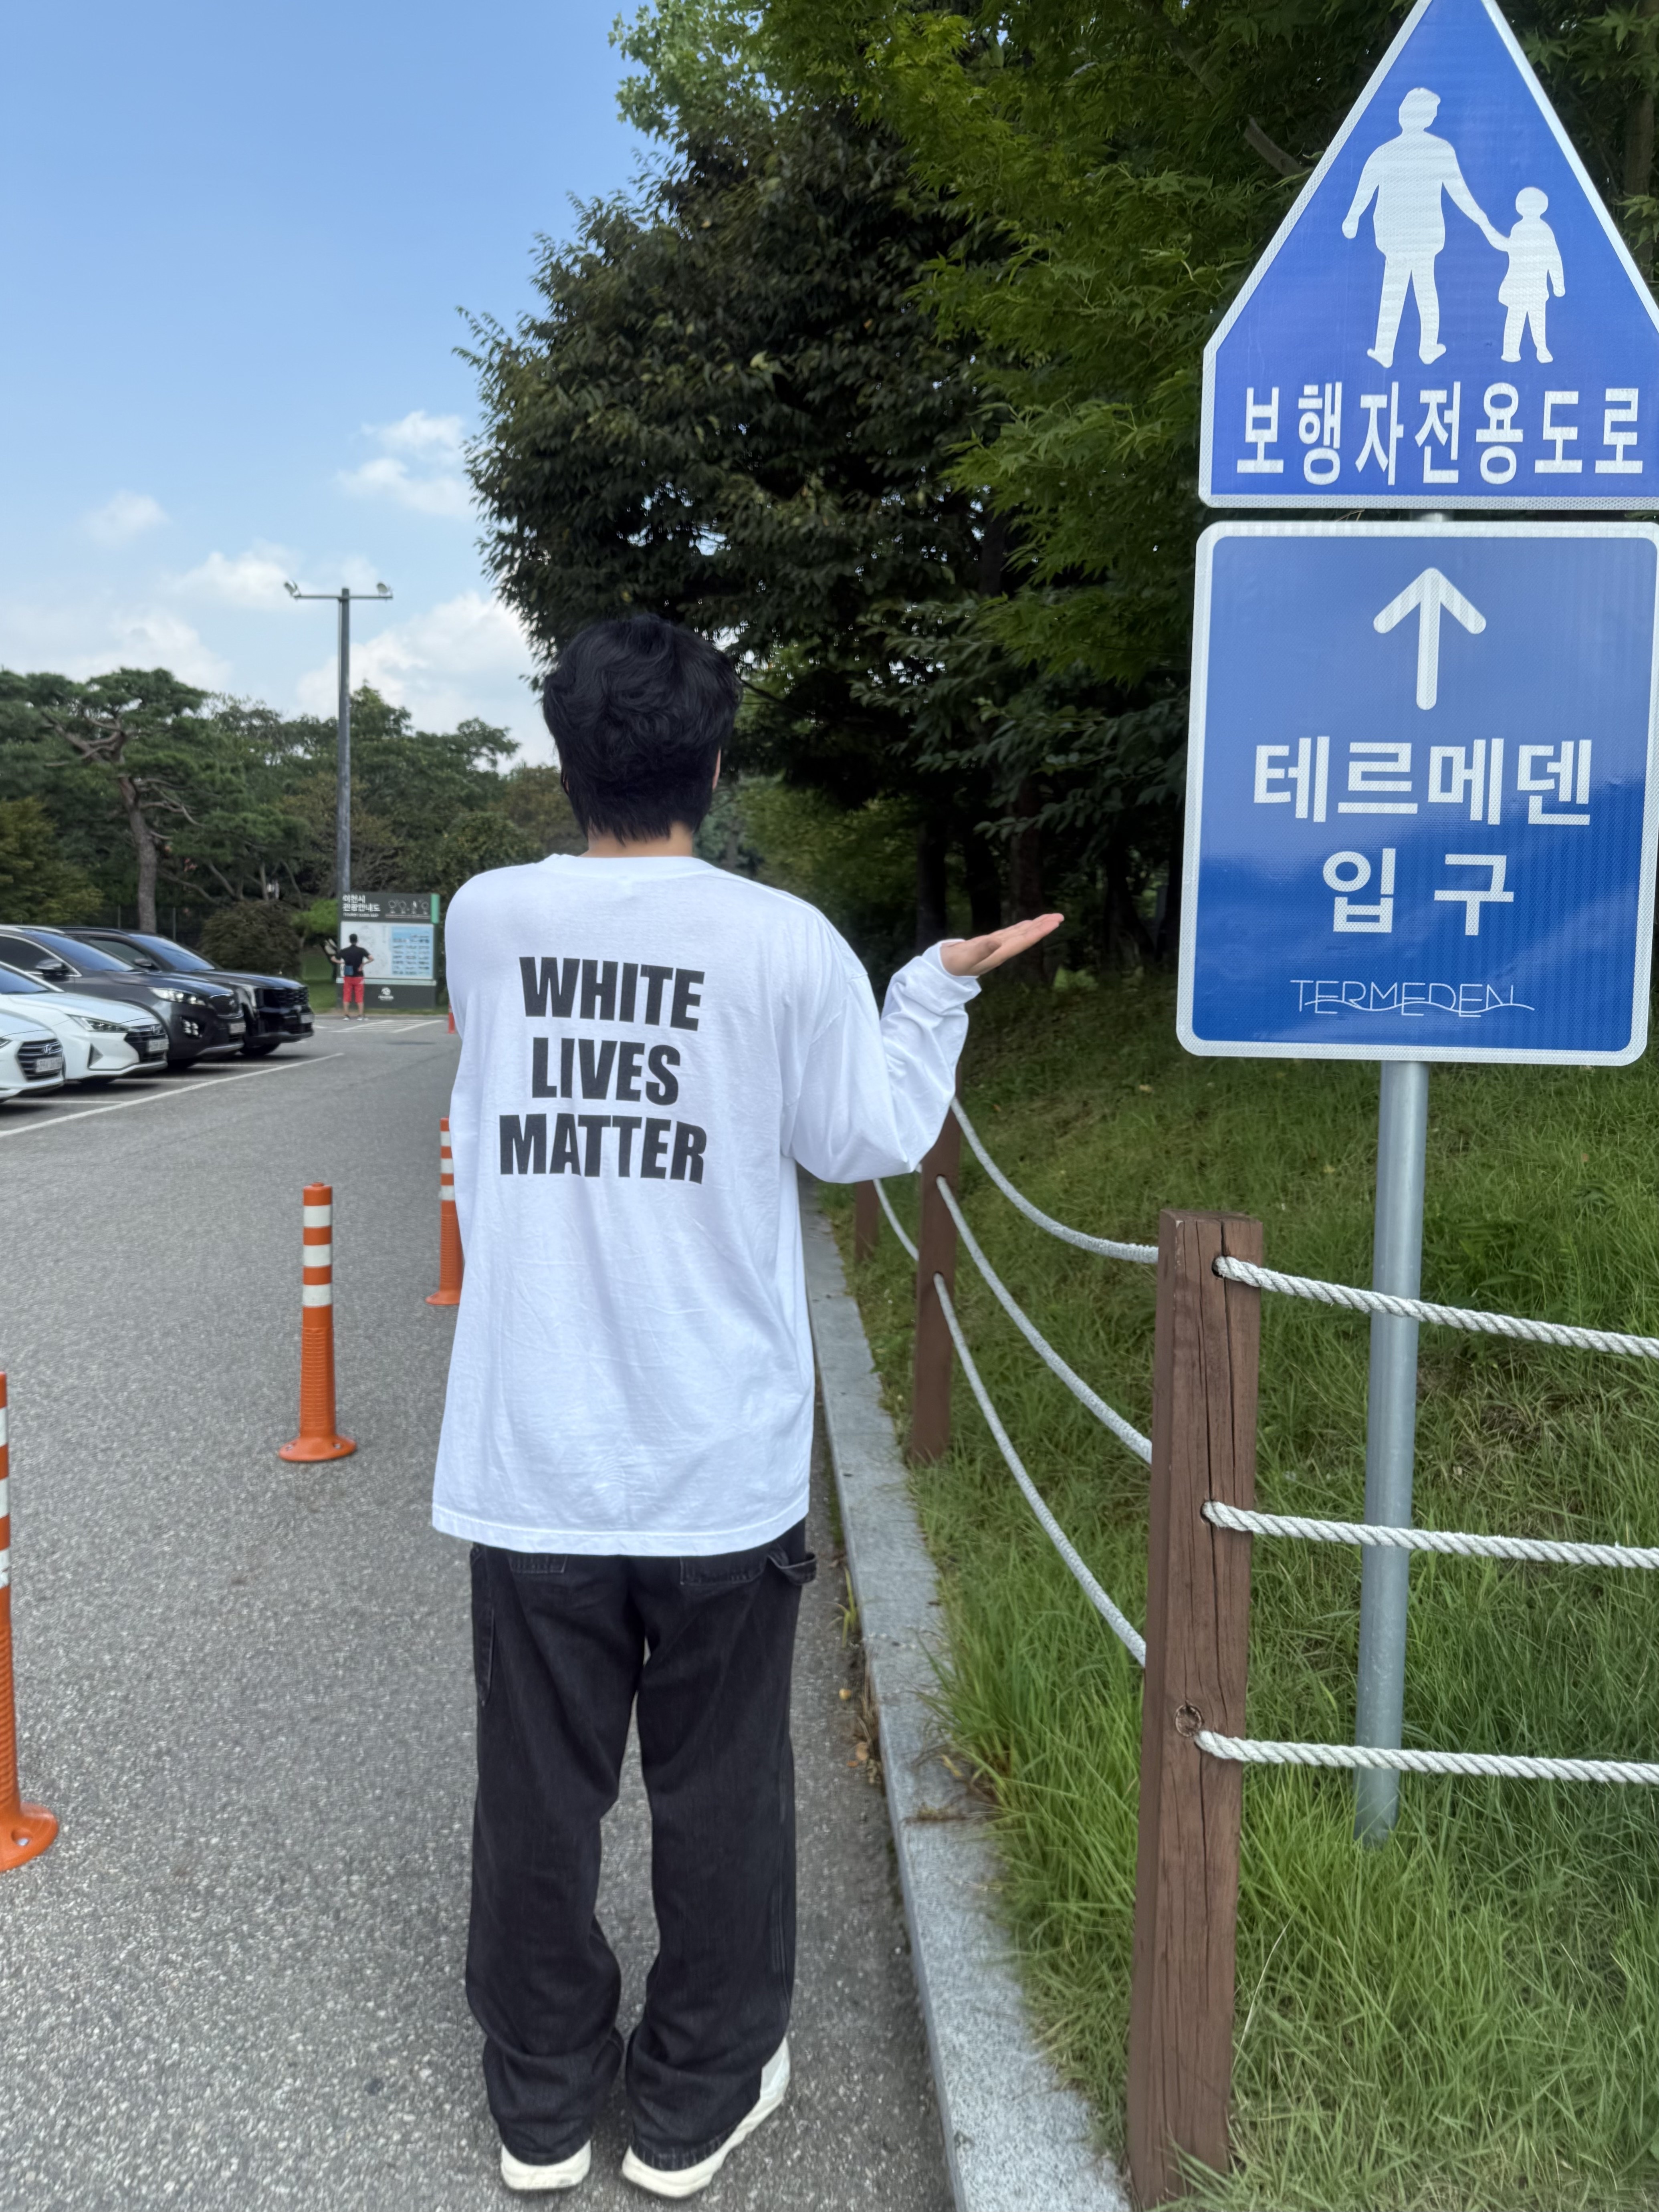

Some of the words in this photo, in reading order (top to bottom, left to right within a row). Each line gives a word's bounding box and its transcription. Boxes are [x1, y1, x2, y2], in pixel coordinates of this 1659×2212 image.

[1237, 381, 1643, 485] 보행자전용도로
[1254, 736, 1592, 825] 테르메덴
[519, 957, 705, 1031] WHITE
[1290, 980, 1535, 1018] TERMEDEN
[532, 1037, 680, 1106] LIVES
[499, 1113, 707, 1184] MATTER
